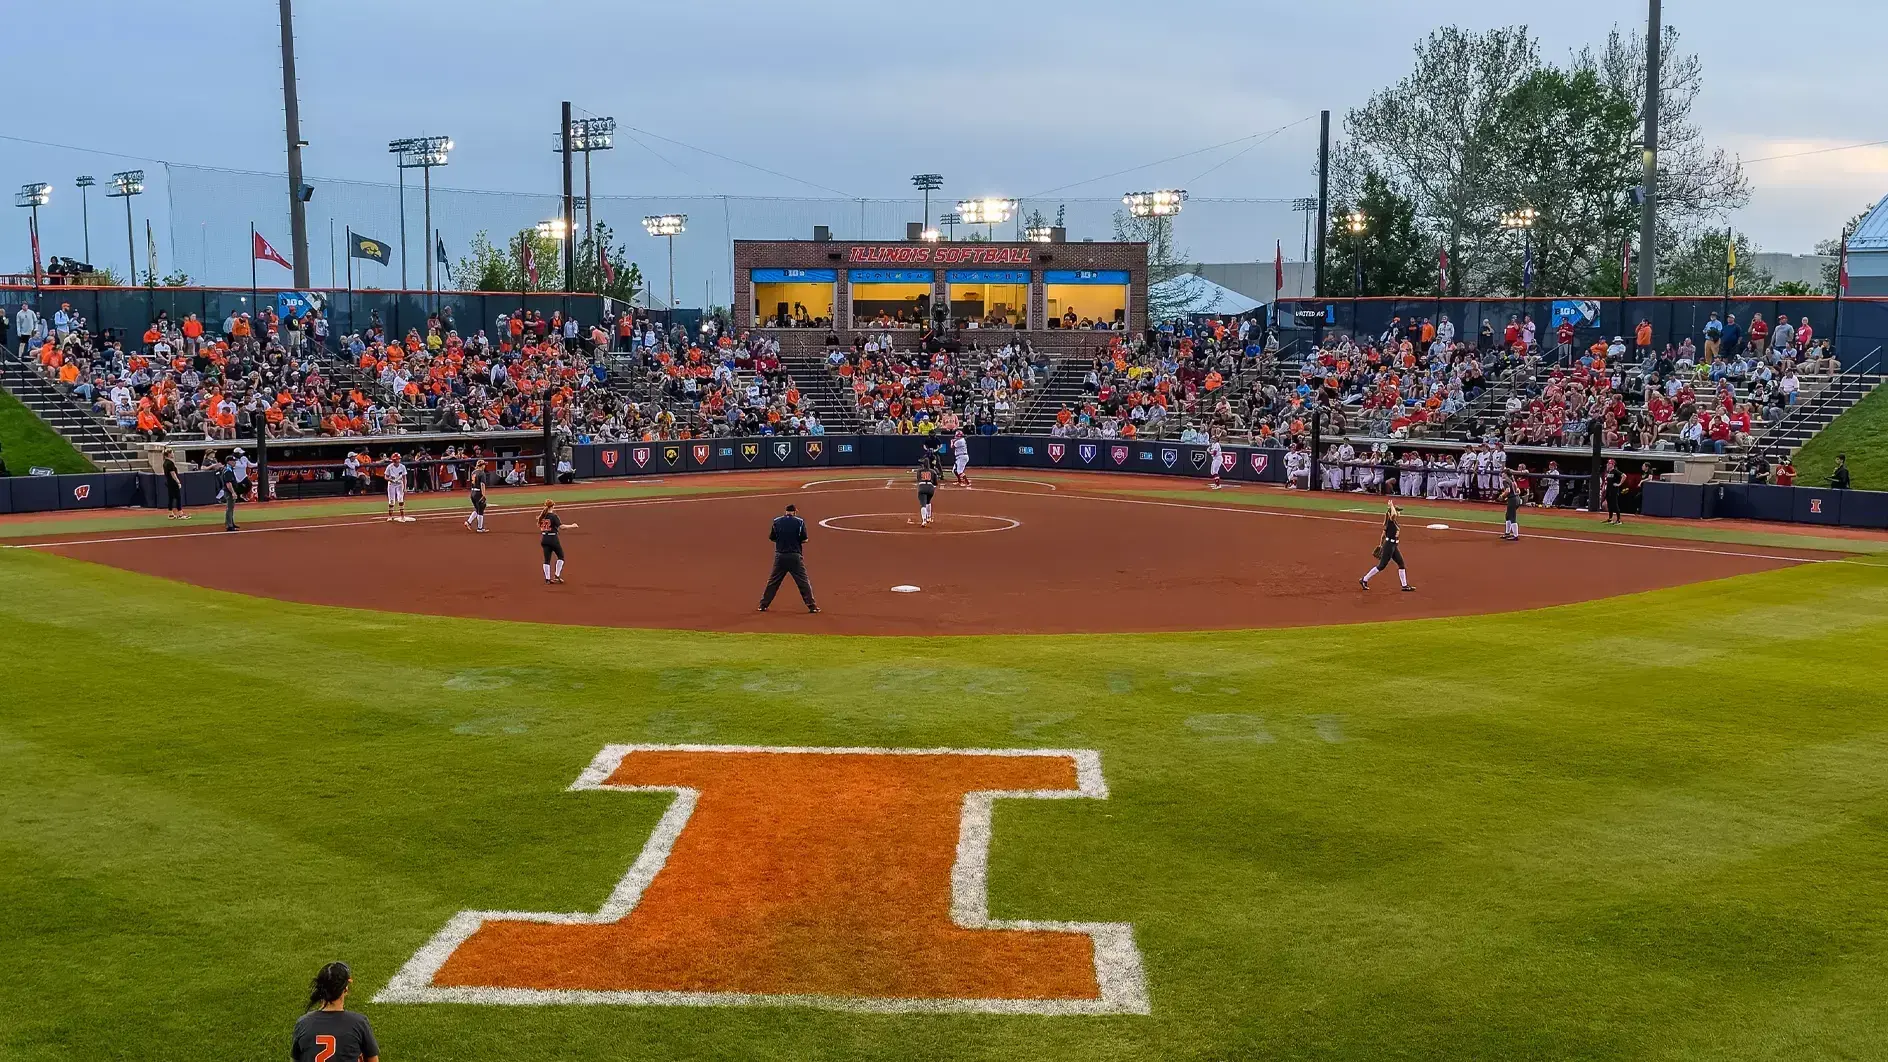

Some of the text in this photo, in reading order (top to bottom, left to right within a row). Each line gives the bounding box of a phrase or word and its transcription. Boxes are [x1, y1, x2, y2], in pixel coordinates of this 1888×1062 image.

[849, 247, 1032, 263] ILLINOIS SOFTBALL
[1326, 305, 1335, 323] 1
[697, 447, 706, 457] M
[744, 445, 756, 455] M
[1052, 446, 1061, 456] N
[1084, 446, 1092, 458] N
[606, 451, 614, 465] I
[1193, 453, 1205, 462] P
[1224, 455, 1233, 465] R
[1811, 499, 1821, 513] I
[372, 742, 1151, 1015] I
[315, 1035, 336, 1062] 2
